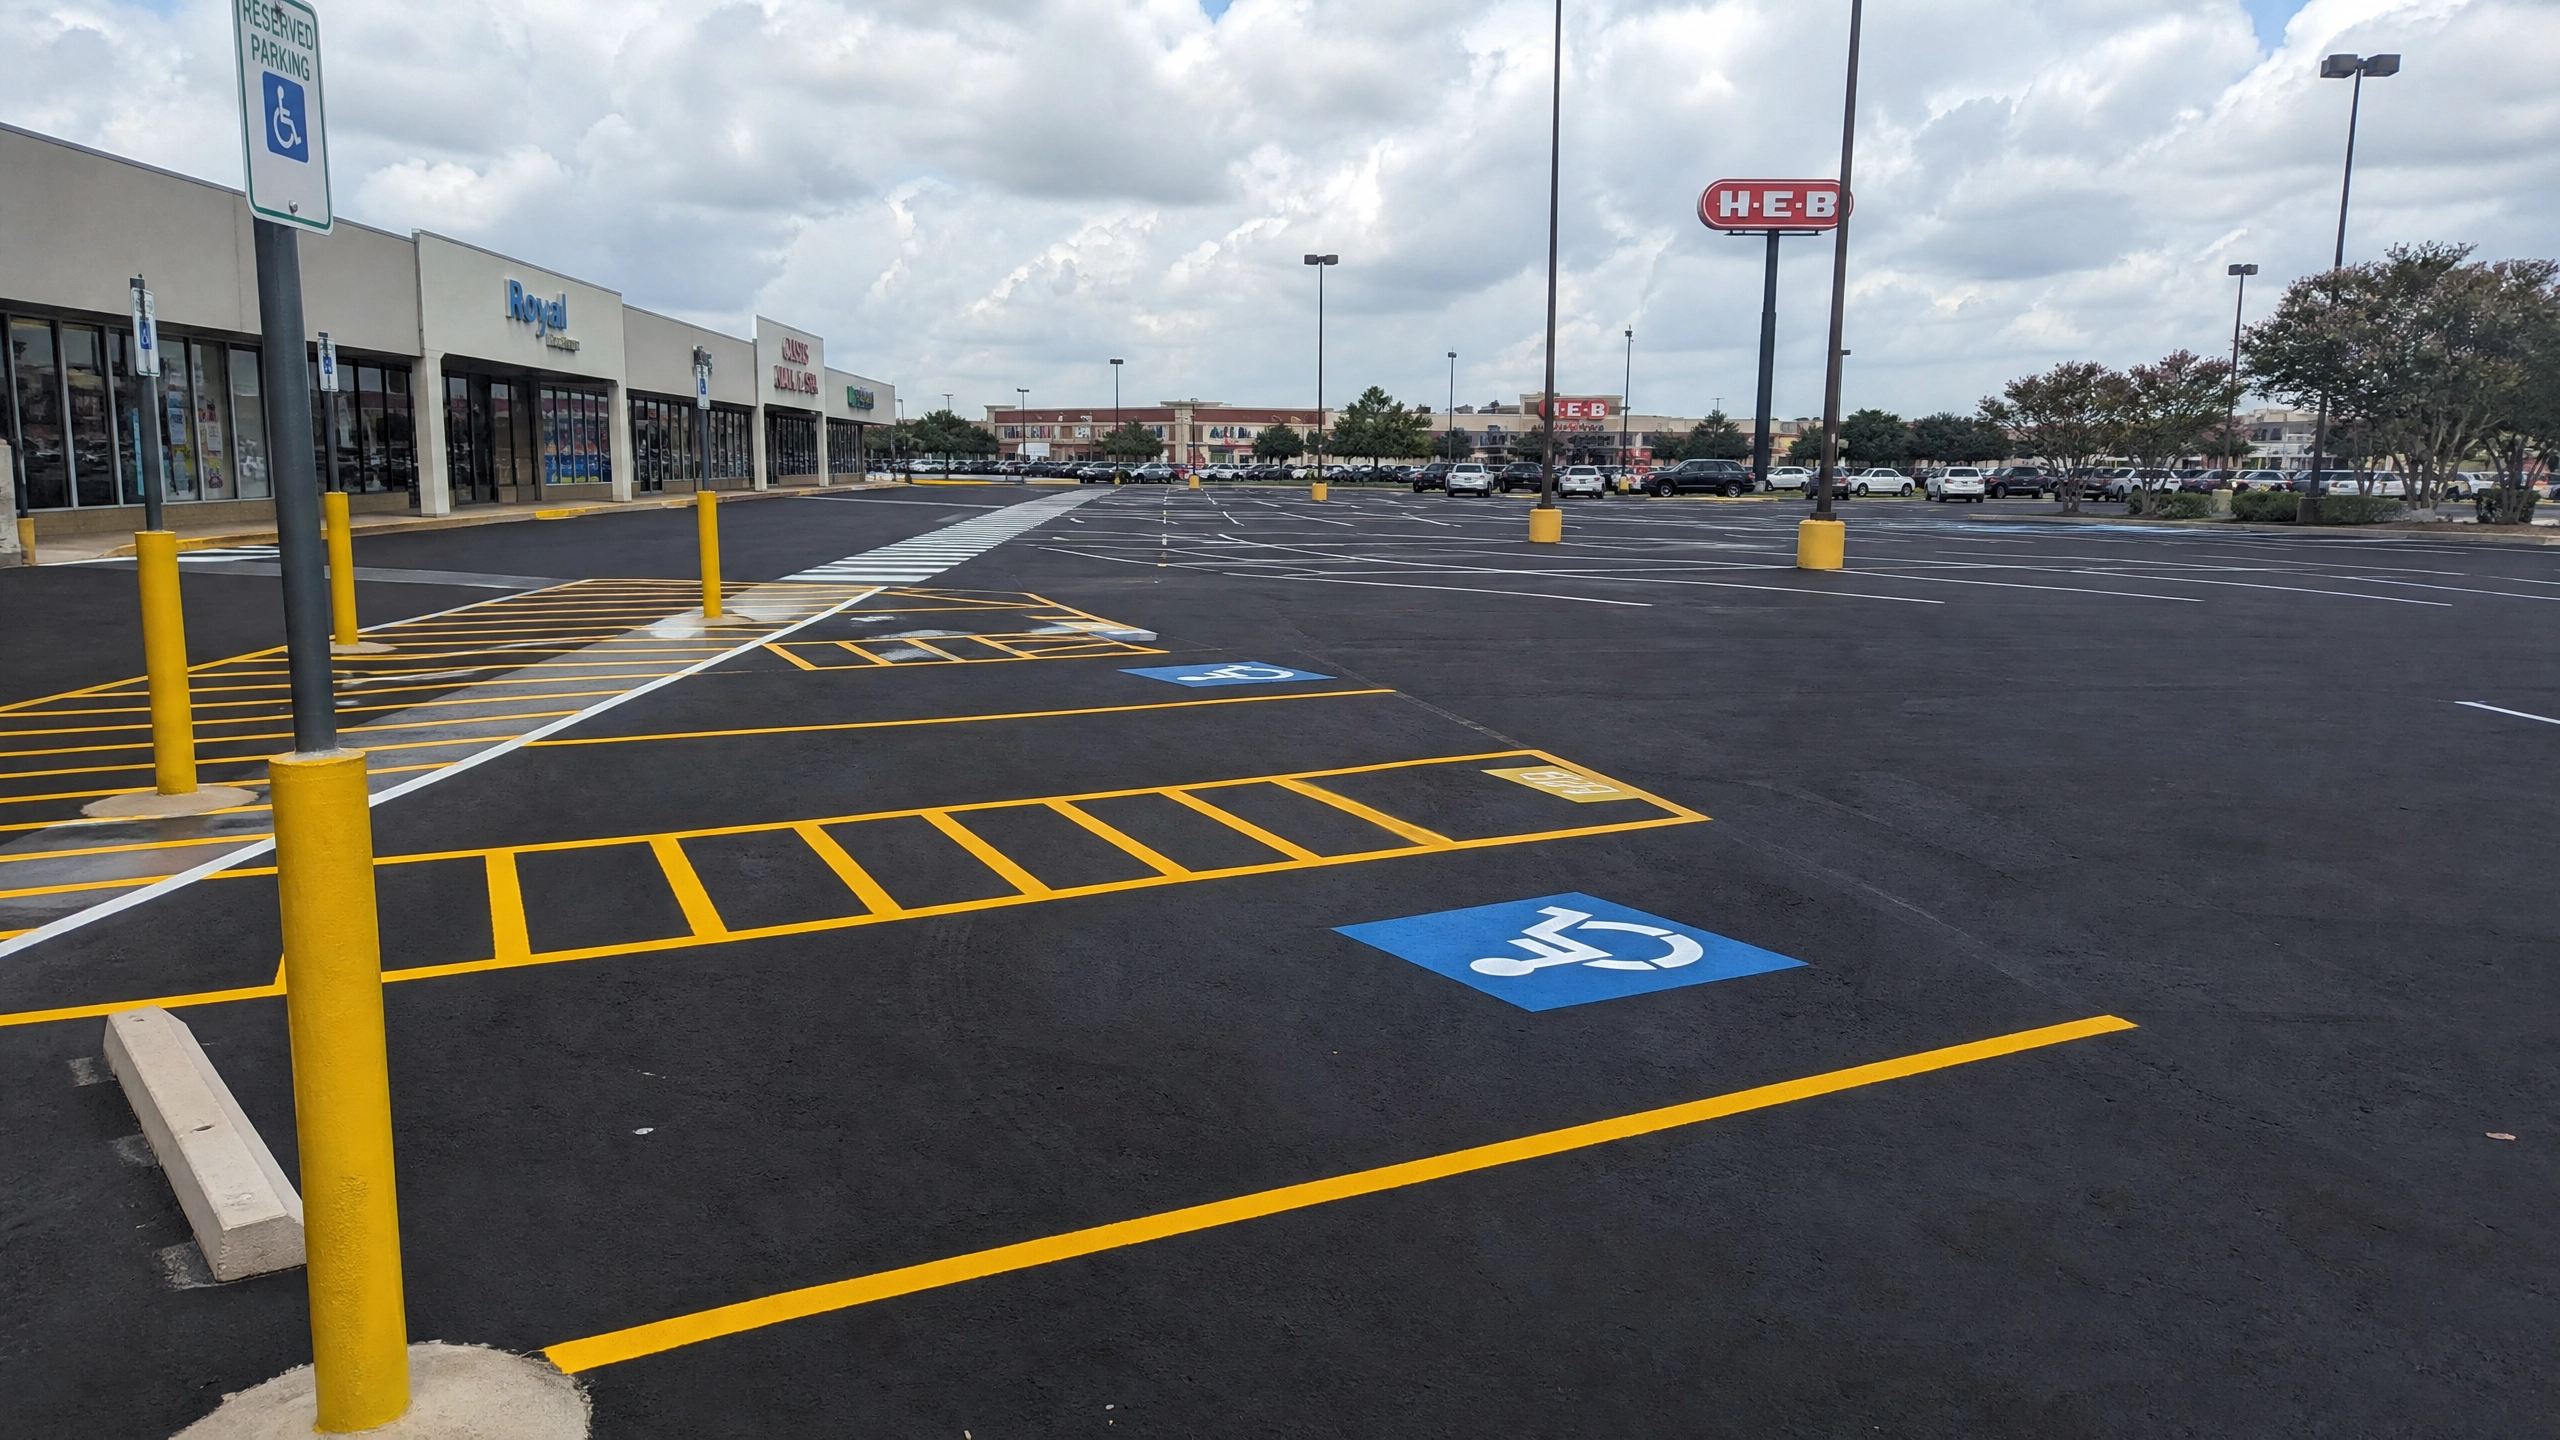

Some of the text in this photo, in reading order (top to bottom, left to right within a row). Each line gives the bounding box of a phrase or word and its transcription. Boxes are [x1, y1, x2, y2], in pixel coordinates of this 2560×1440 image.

[242, 0, 314, 51] RESERVED
[250, 33, 310, 82] PARKING
[505, 278, 567, 337] Royal
